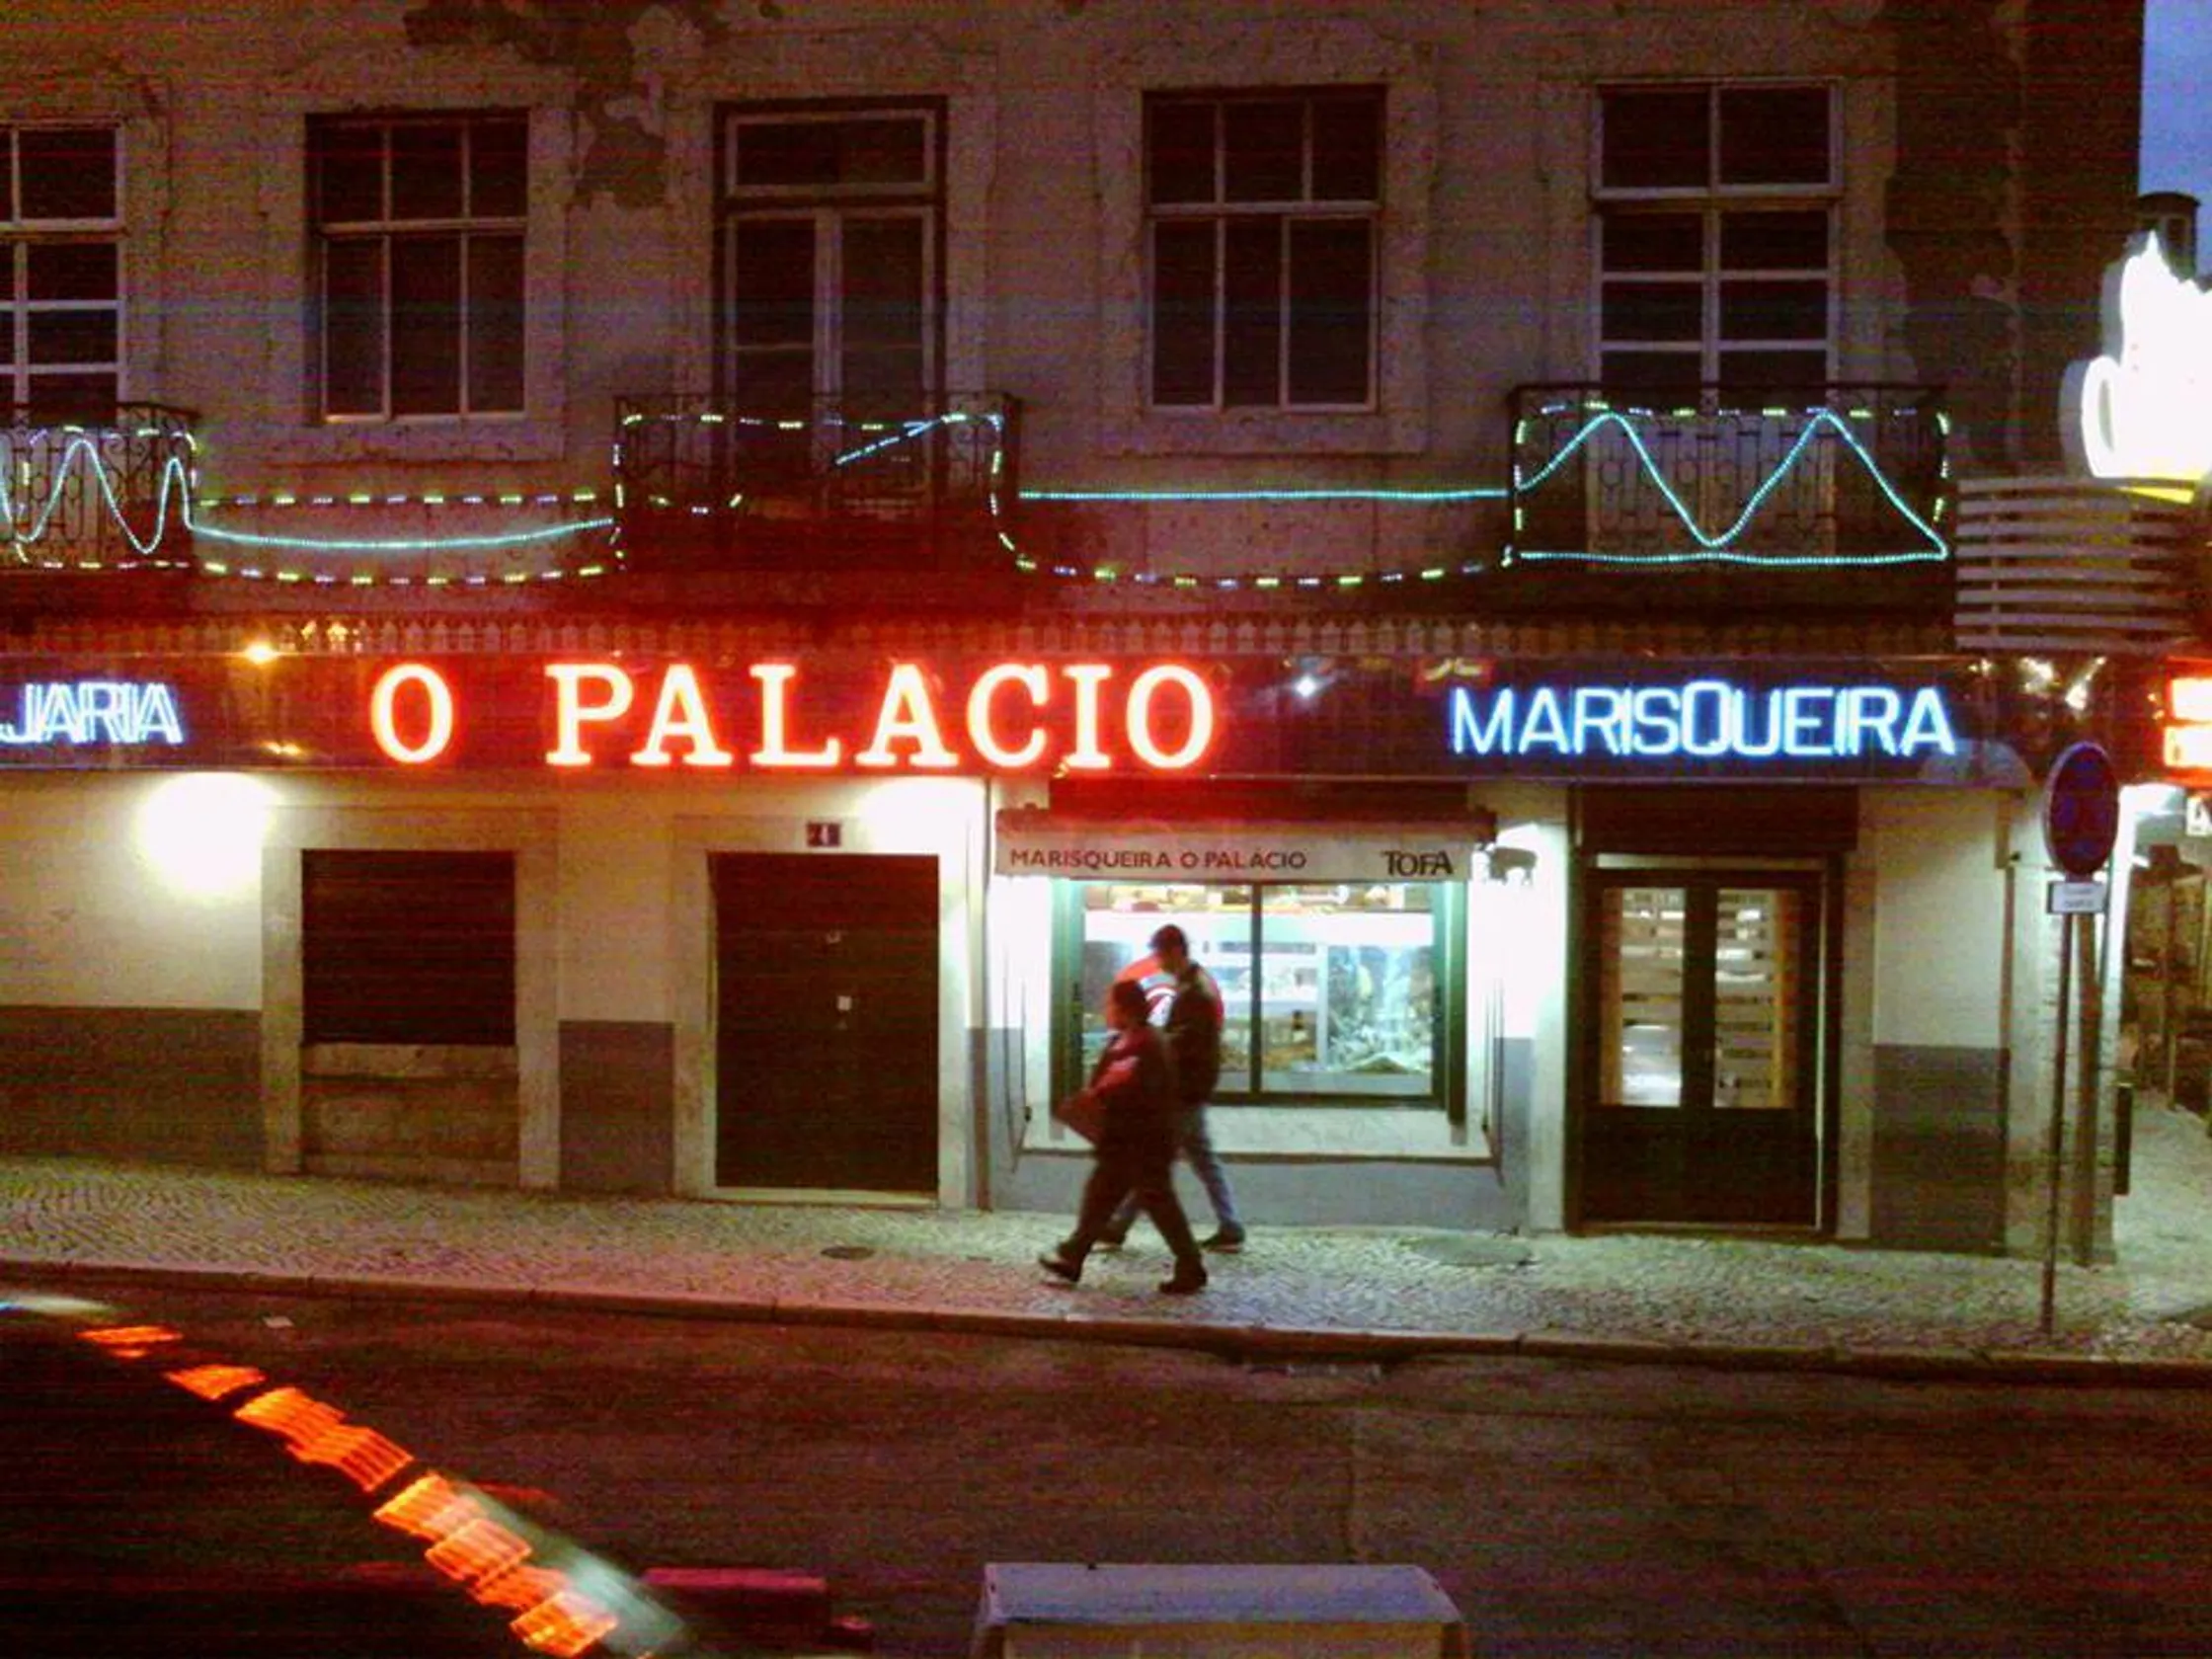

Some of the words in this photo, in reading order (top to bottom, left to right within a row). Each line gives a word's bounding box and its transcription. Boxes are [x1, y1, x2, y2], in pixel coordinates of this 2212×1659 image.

[370, 663, 453, 765] O
[544, 663, 1214, 769] PALACIO
[1452, 679, 1958, 756] MARISQUEIRA
[1009, 848, 1171, 871] MARISQUEIRA
[1180, 851, 1199, 870] O
[1382, 850, 1454, 878] TOFA
